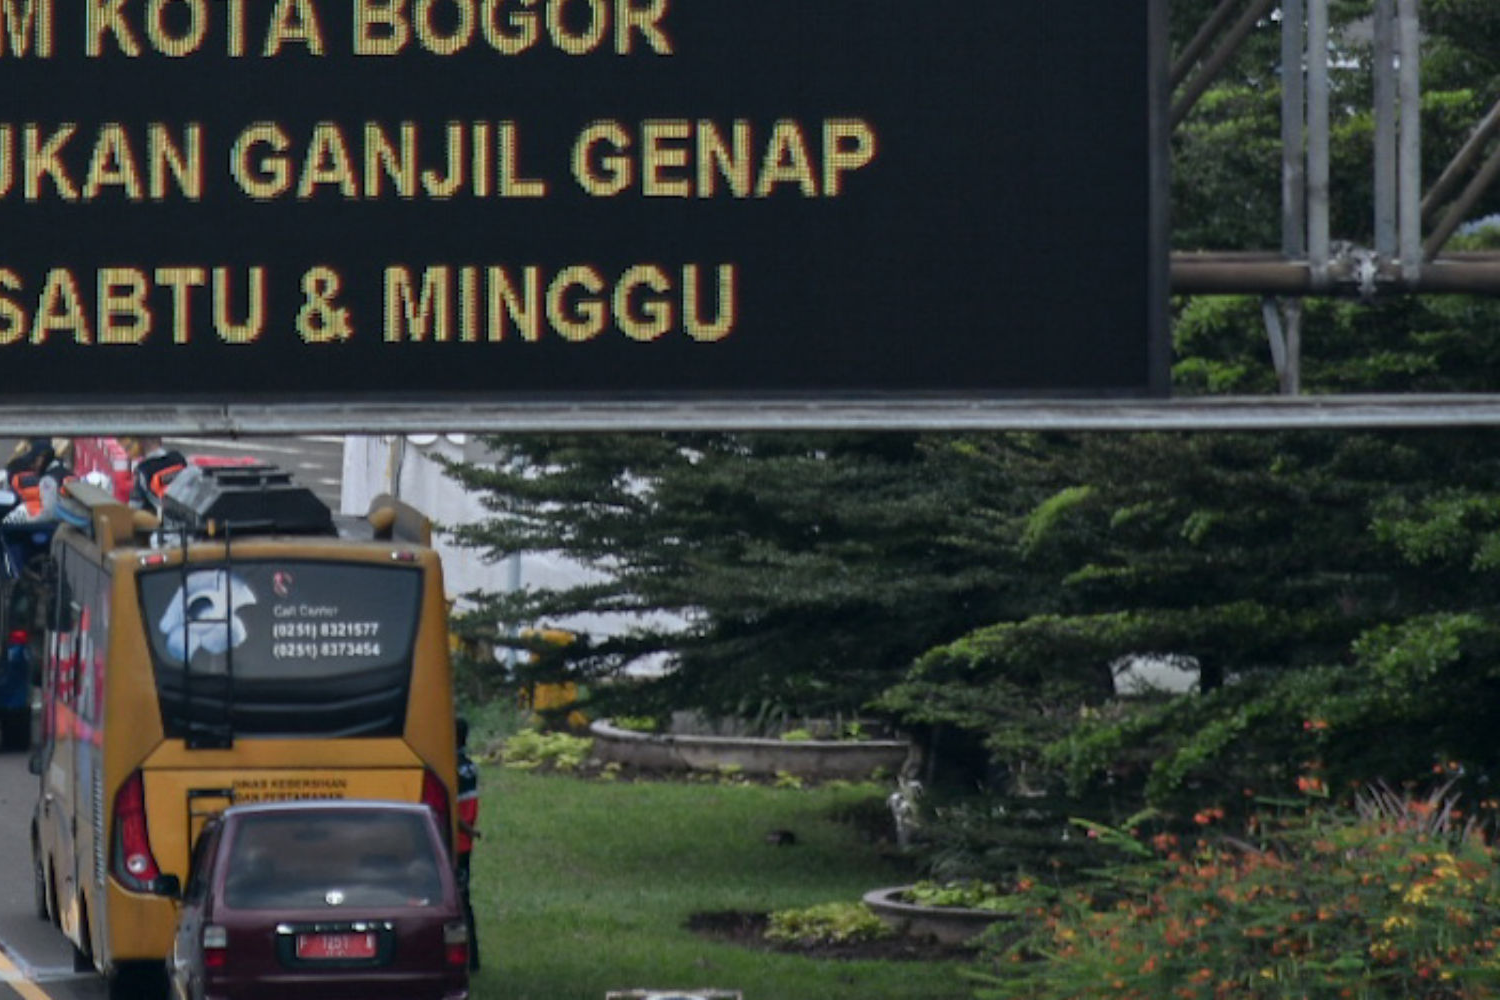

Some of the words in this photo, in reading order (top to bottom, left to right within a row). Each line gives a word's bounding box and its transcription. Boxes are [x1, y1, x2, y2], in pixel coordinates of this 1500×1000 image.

[230, 121, 546, 200] GANJIL
[571, 119, 875, 198] GENAP
[295, 266, 352, 344] &
[383, 264, 734, 342] MINGGU
[273, 622, 317, 640] (0251)
